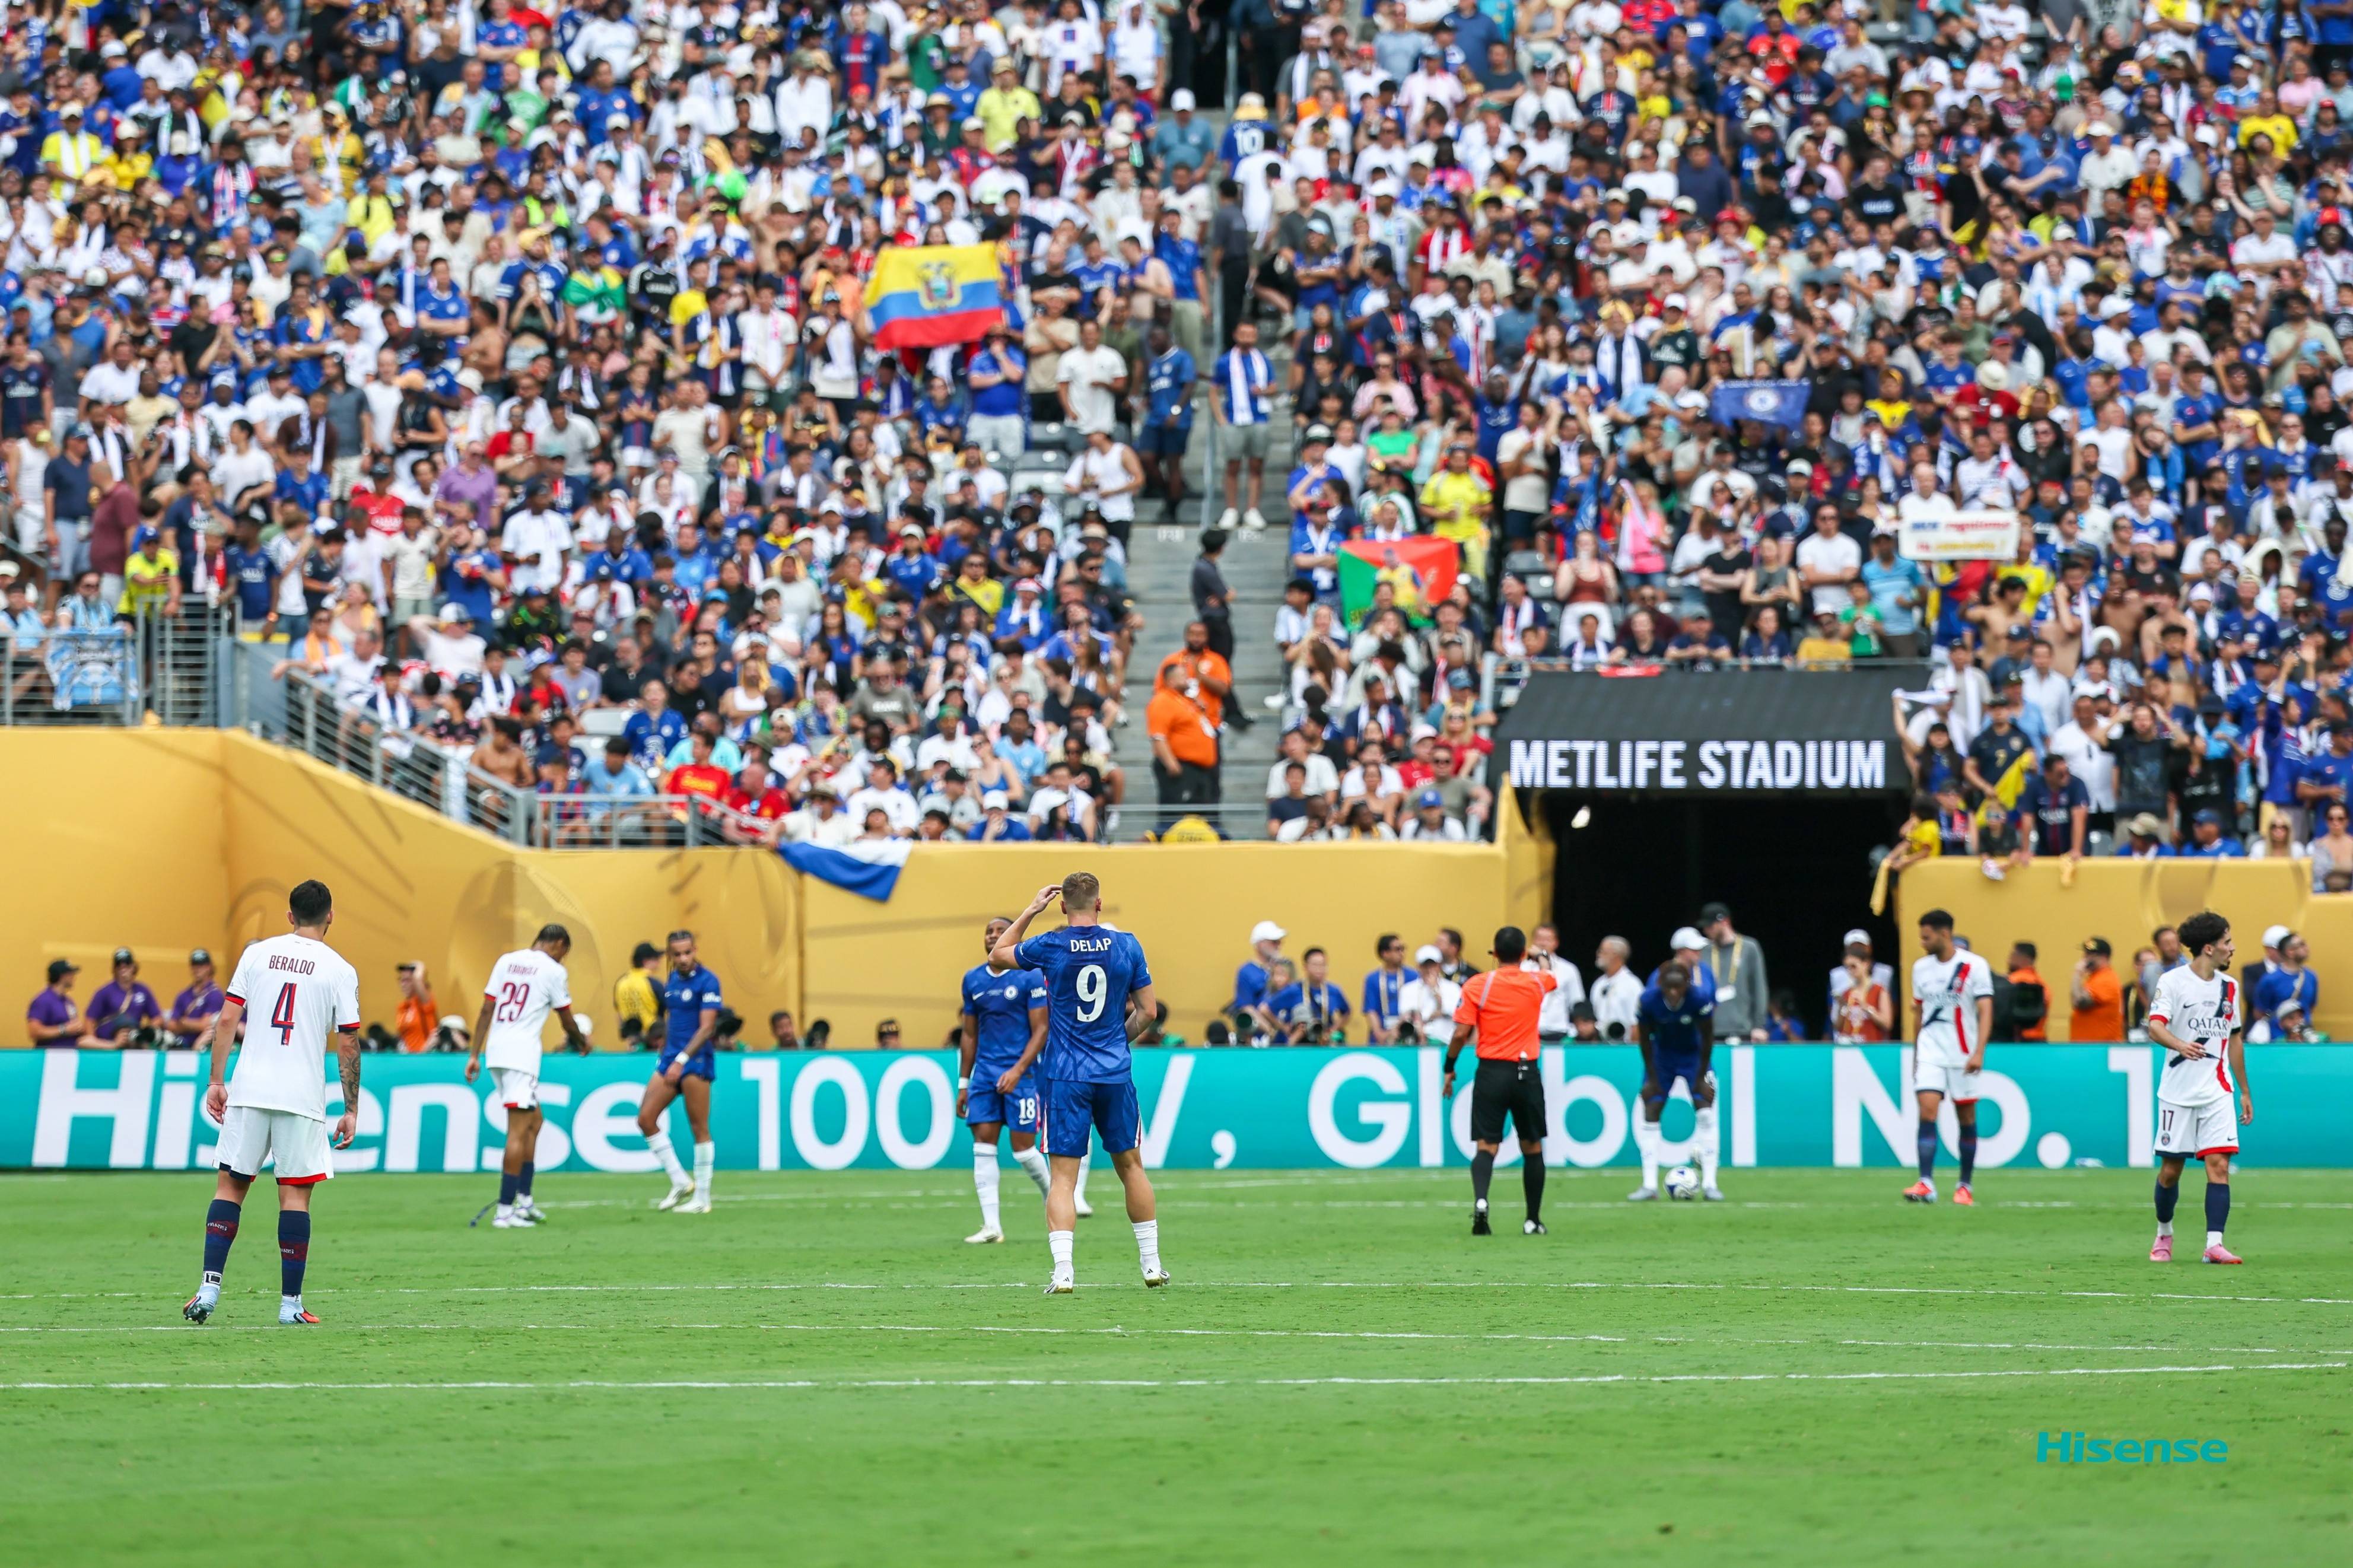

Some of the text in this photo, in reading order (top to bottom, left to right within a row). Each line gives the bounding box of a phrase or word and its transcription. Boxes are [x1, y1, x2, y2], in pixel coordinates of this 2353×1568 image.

[1510, 740, 1885, 789] METLIFE STADIUM
[1070, 938, 1112, 952] DELAP
[269, 955, 315, 975] BERALDO
[497, 982, 530, 1022] 29
[1076, 964, 1107, 1022] 9
[271, 982, 297, 1046] 4
[2188, 1017, 2228, 1031] QATAR
[740, 1055, 956, 1171] 100
[1832, 1048, 2071, 1169] No.
[2107, 1048, 2154, 1168] 1
[1019, 1098, 1036, 1119] 18
[2163, 1109, 2174, 1131] 17
